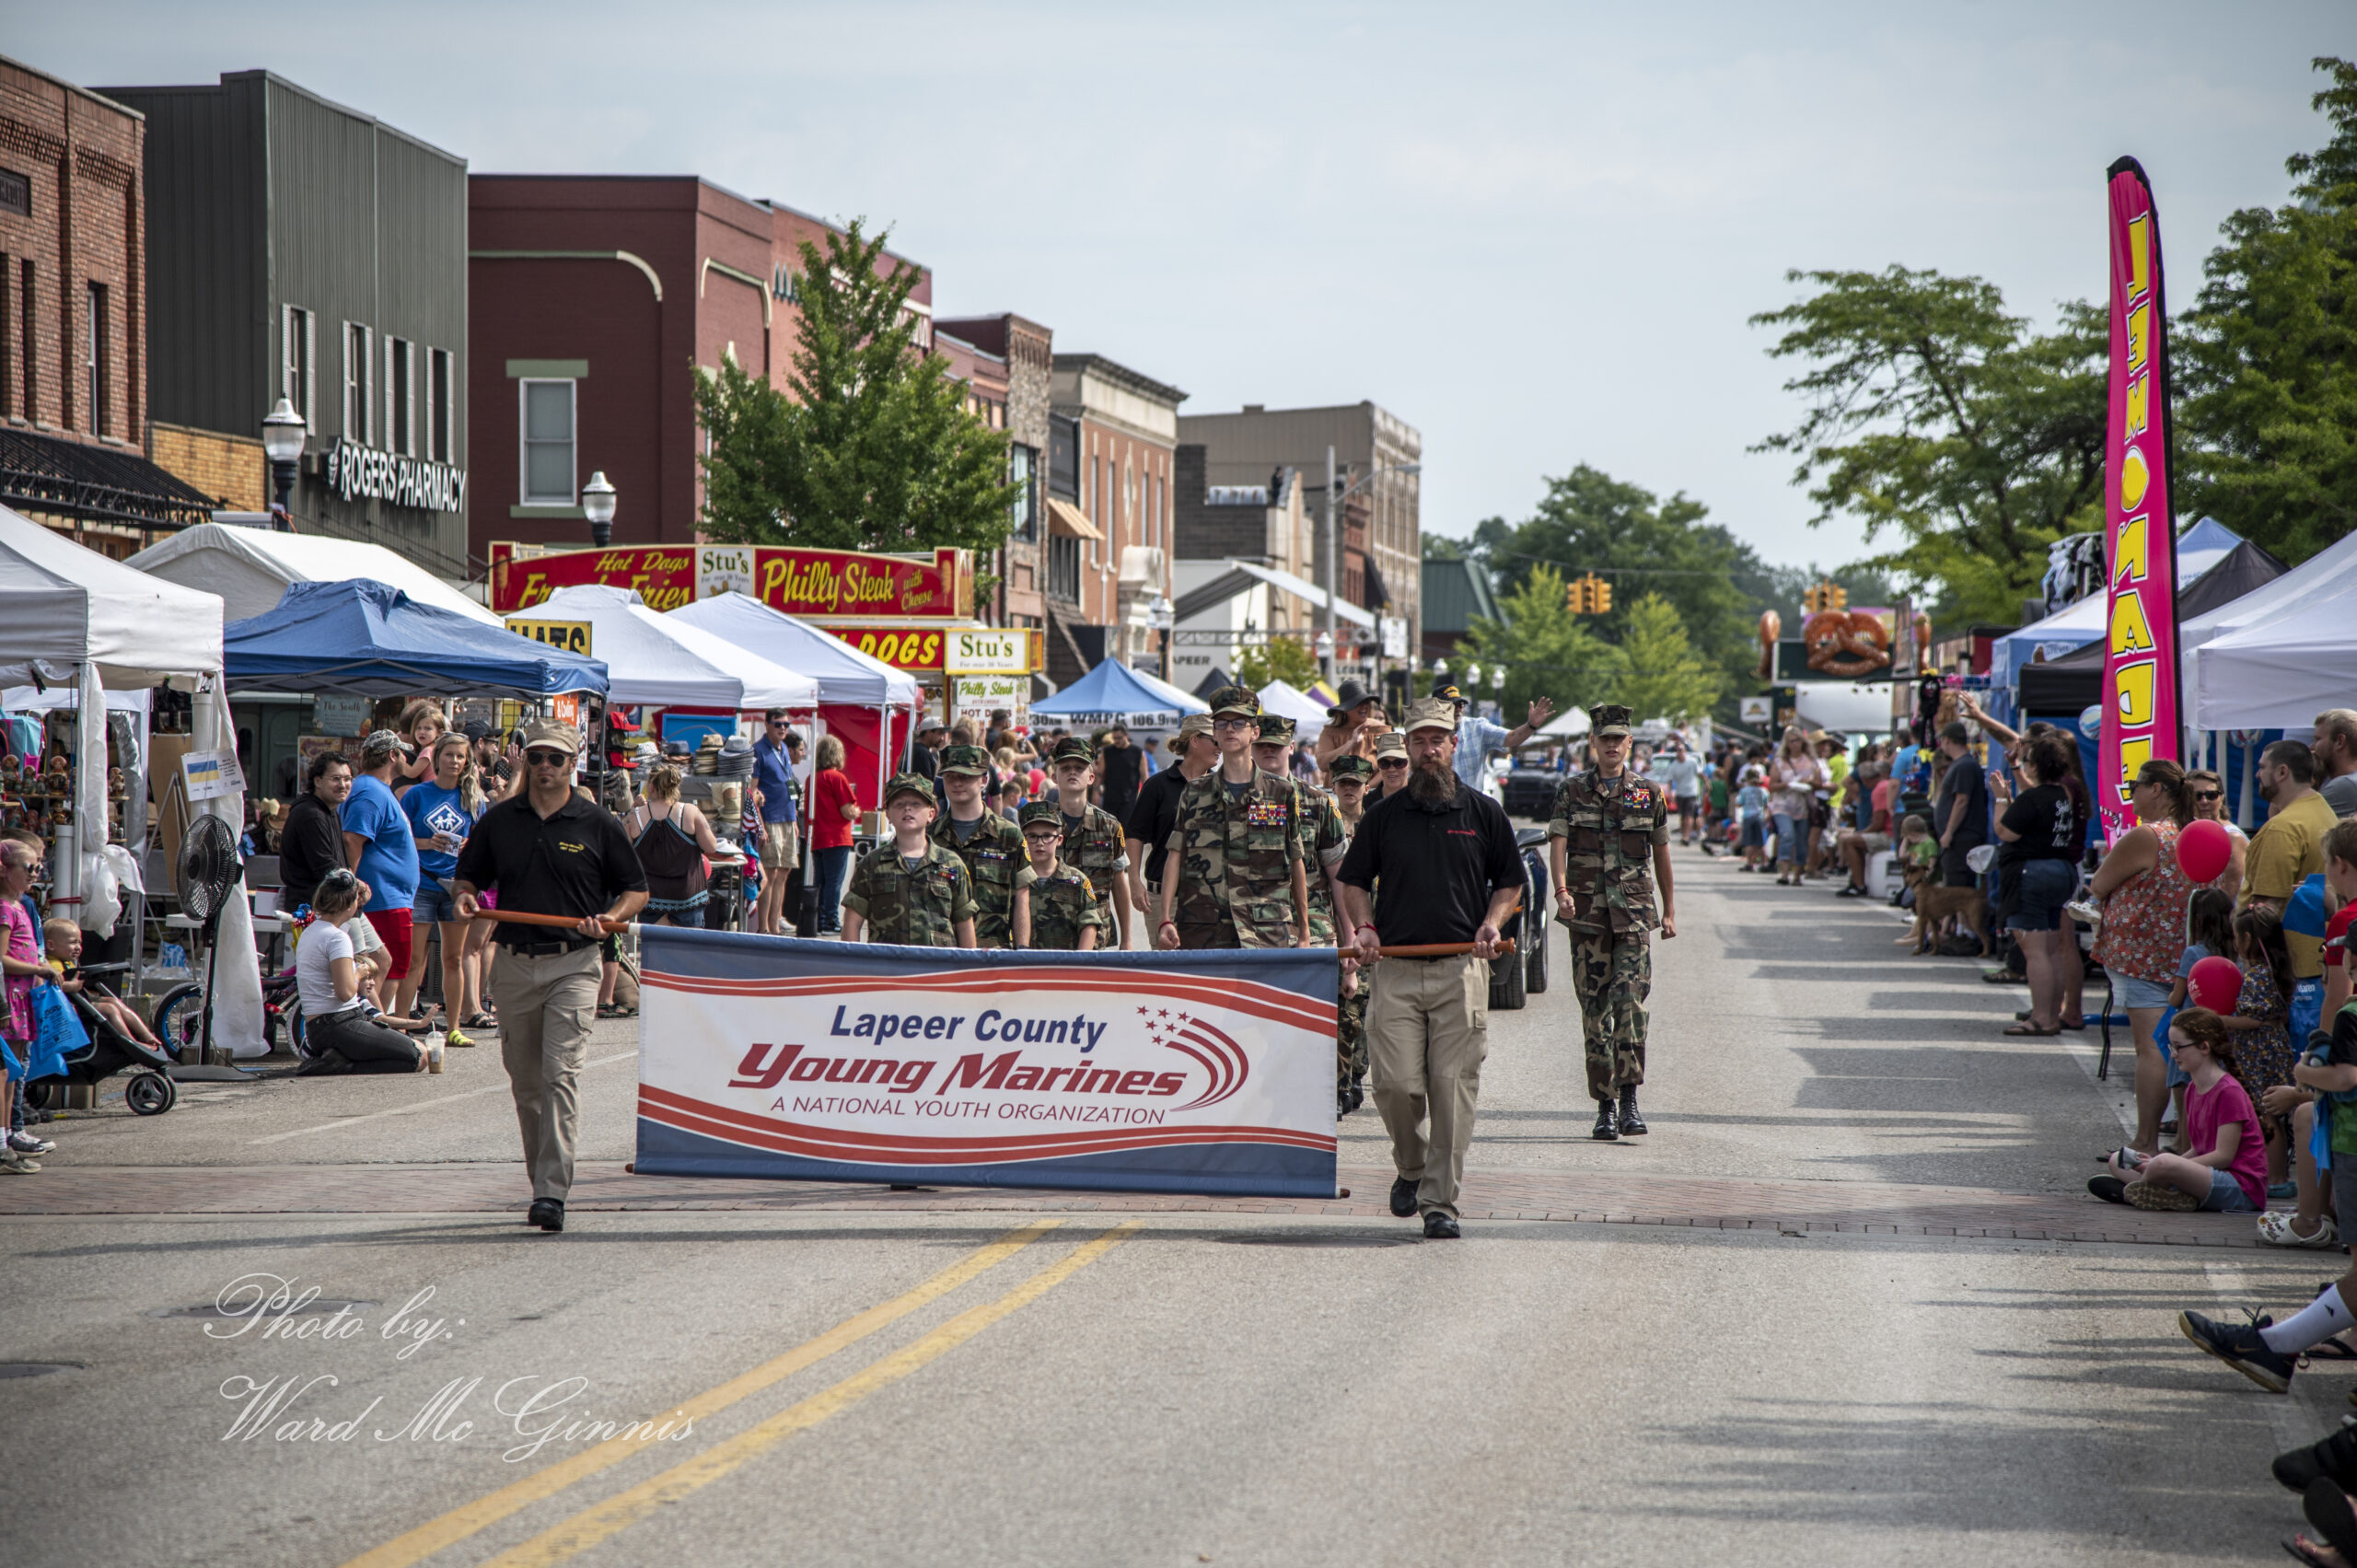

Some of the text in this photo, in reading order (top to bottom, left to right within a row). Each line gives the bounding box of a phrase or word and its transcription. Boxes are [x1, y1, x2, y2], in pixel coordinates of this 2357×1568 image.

[341, 444, 467, 514] ROGERS PHARMACY
[594, 552, 690, 575] Hot Dogs
[702, 551, 749, 575] Stu's
[762, 557, 923, 613] Philly Steak with
[901, 589, 934, 611] Cheese
[858, 633, 940, 665] DOGS
[960, 633, 1014, 657] Stu's
[959, 681, 987, 699] Philly
[990, 681, 1014, 695] Steak
[961, 709, 981, 717] HOT
[830, 1005, 1108, 1053] Lapeer County
[727, 1043, 1188, 1096] Young Marines
[770, 1097, 1166, 1125] A NATIONAL YOUTH ORGANIZATION
